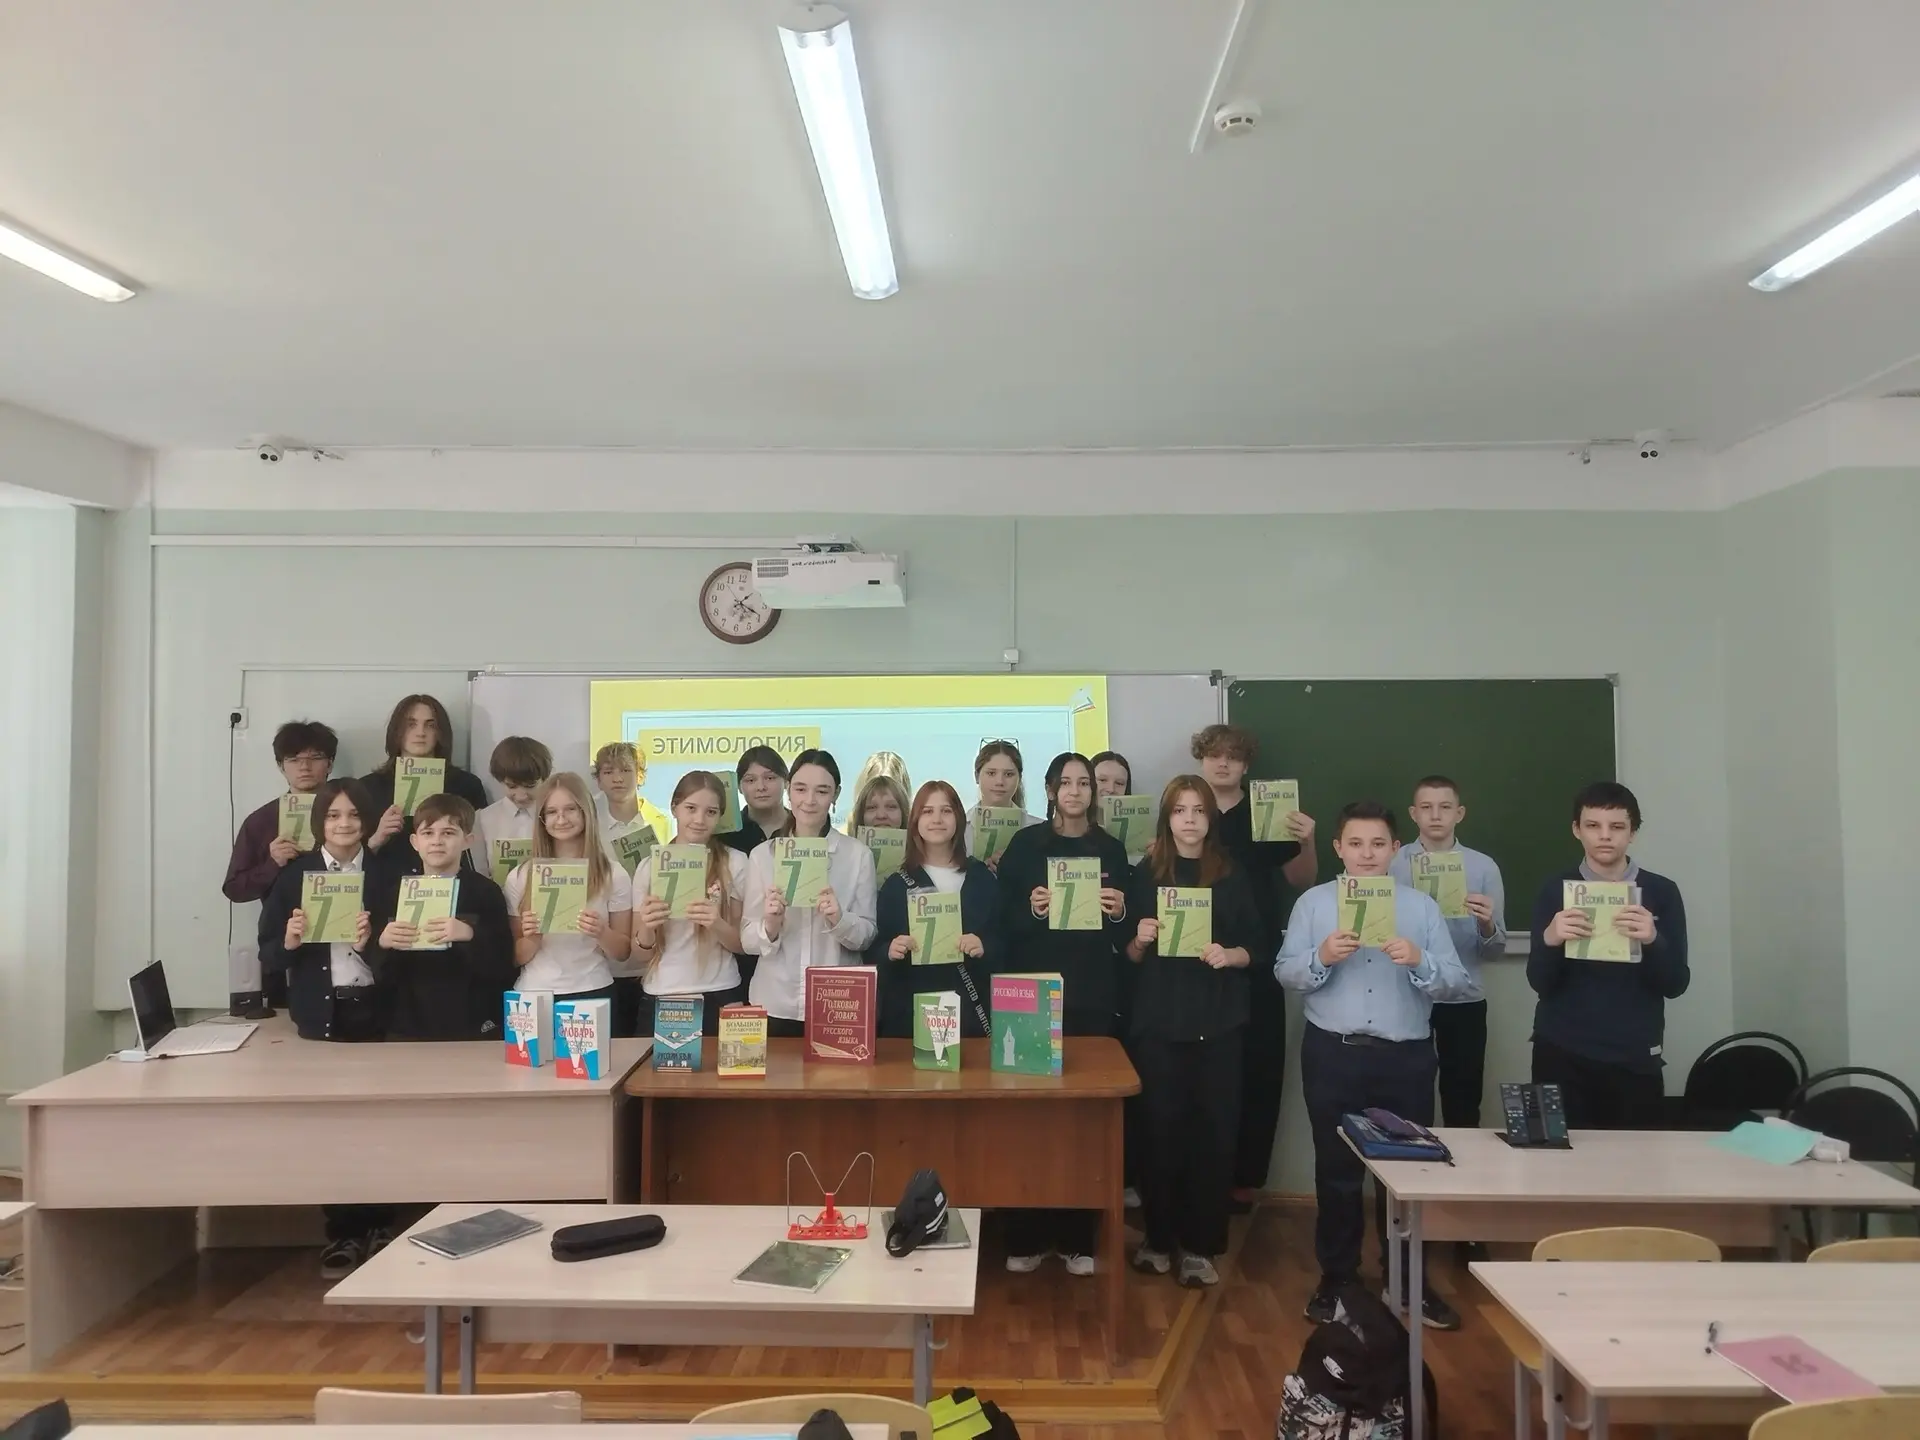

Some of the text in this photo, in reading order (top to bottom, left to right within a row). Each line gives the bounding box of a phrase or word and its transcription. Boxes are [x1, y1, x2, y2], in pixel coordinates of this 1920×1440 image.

[716, 583, 724, 591] 10
[727, 576, 734, 584] 11
[739, 574, 747, 583] 12
[712, 595, 717, 603] 9
[713, 608, 719, 616] 8
[722, 618, 726, 627] 7
[734, 624, 739, 632] 6
[746, 622, 752, 630] 5
[652, 736, 806, 754] ЭТИМОЛОГИЯ
[402, 758, 427, 775] Русский
[402, 777, 420, 816] 7
[1257, 784, 1280, 800] Русский
[1114, 799, 1135, 816] Русский
[286, 814, 305, 840] 7
[981, 809, 1004, 827] Русский
[1256, 802, 1274, 840] 7
[866, 829, 888, 847] Русский
[1112, 818, 1129, 844] 7
[784, 839, 810, 859] Русский
[980, 828, 998, 860] 7
[658, 851, 686, 871] Русский
[539, 866, 567, 887] Русский
[1056, 862, 1081, 881] Русский
[312, 876, 341, 895] Русский
[405, 880, 433, 900] Русский
[658, 872, 678, 911] 7
[782, 861, 801, 906] 7
[1346, 879, 1374, 899] Русский
[1419, 876, 1439, 901] 7
[916, 896, 958, 916] Русский язык
[1055, 882, 1075, 929] 7
[1166, 889, 1192, 909] Русский
[311, 896, 333, 941] 7
[404, 901, 424, 929] 7
[539, 888, 559, 934] 7
[1345, 900, 1367, 941] 7
[916, 917, 936, 964] 7
[1165, 911, 1185, 957] 7
[956, 964, 978, 1002] UNAFFECTED
[816, 988, 850, 1000] БОЛЬШОЙ
[822, 999, 860, 1013] ТОЛКОВЫЙ
[827, 1010, 858, 1024] СЛОВАРЬ
[823, 1027, 853, 1035] РУССКОГО
[838, 1036, 859, 1044] ЯЗЫКА
